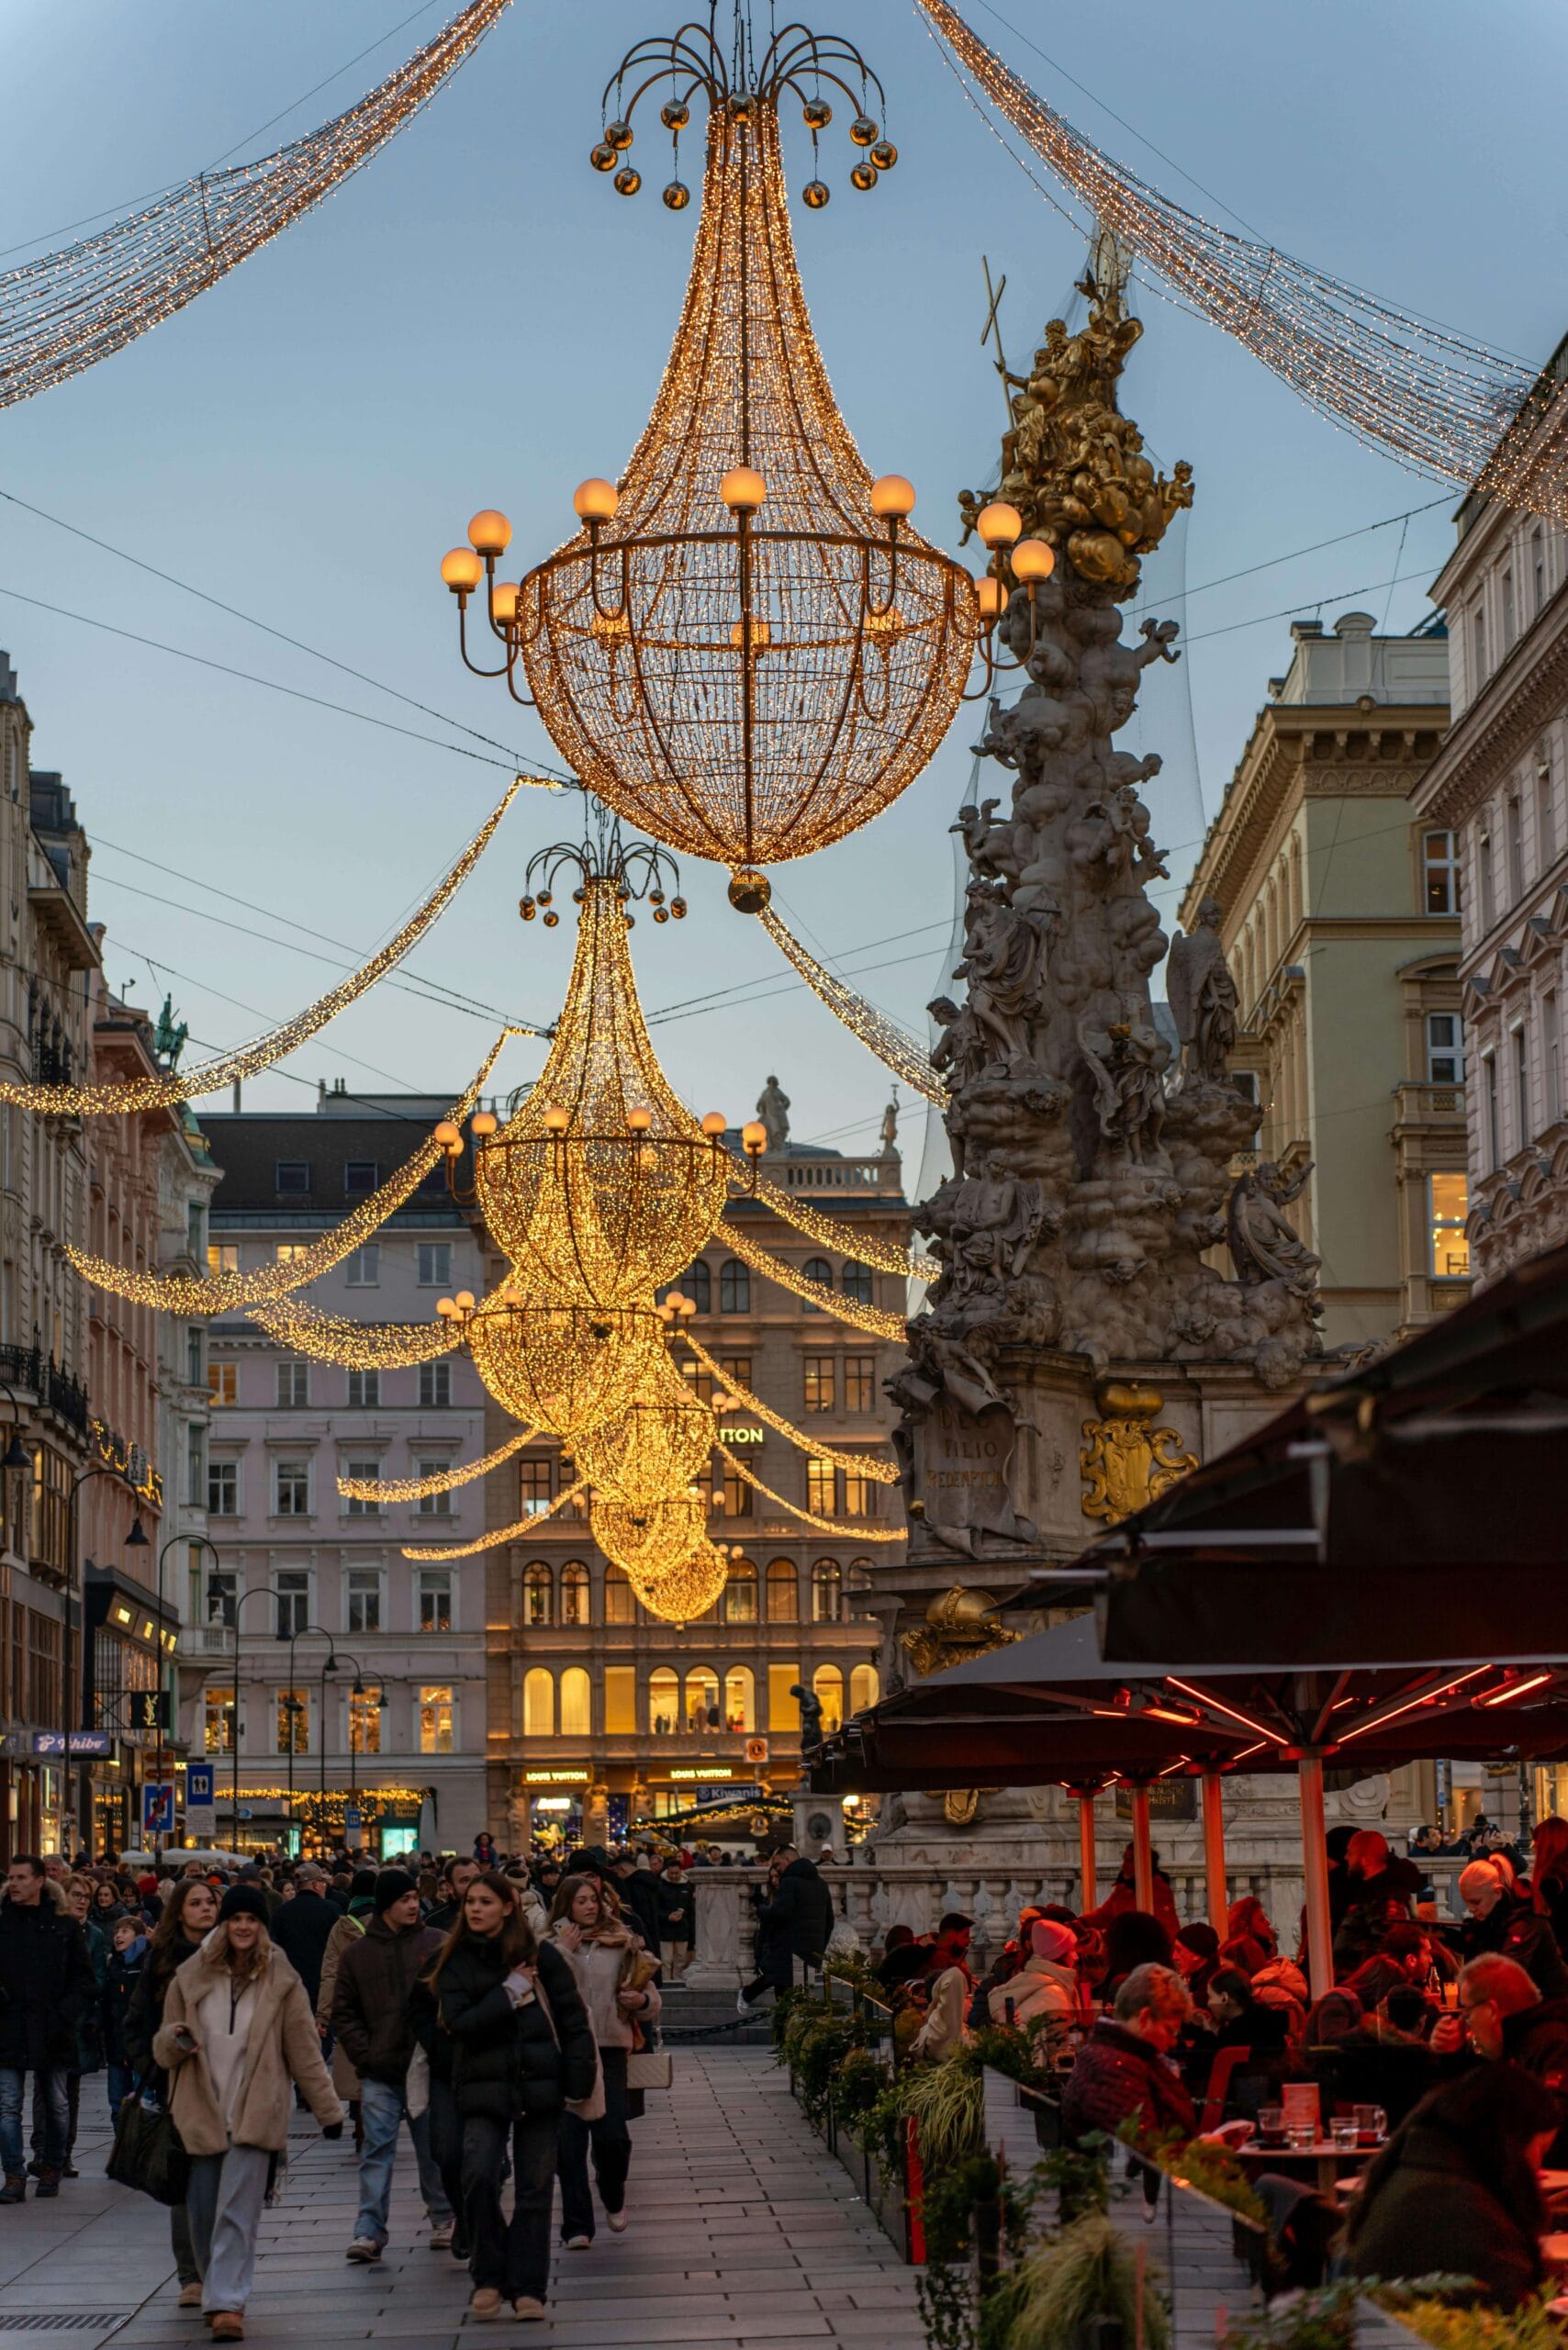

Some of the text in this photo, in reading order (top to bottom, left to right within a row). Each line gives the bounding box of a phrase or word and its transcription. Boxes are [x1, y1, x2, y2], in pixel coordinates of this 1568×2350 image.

[57, 1737, 105, 1750] Thibo
[526, 1771, 588, 1782] LOUIS VUITTON
[670, 1769, 732, 1779] LOUIS VUITTON
[711, 1787, 761, 1799] Kiwanis
